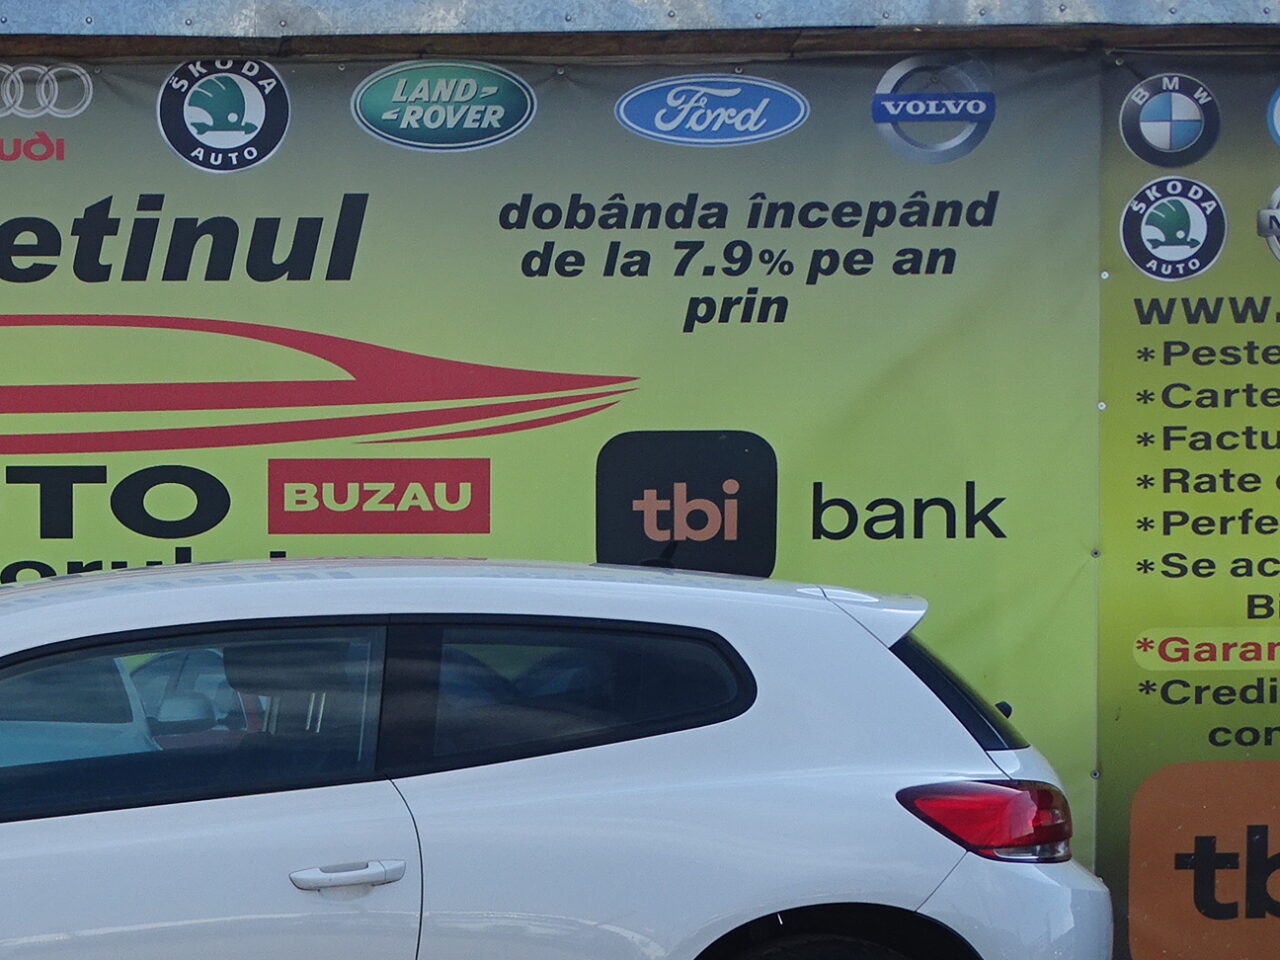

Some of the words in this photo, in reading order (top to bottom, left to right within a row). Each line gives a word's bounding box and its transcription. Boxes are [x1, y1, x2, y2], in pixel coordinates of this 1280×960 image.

[654, 85, 770, 131] Ford
[881, 99, 987, 115] VOLVO
[1131, 76, 1213, 106] BMW
[190, 146, 258, 166] AUTO
[499, 193, 727, 230] dobânda
[746, 191, 999, 237] începând
[520, 241, 585, 277] de
[603, 241, 652, 277] la
[672, 240, 794, 277] 7.9%
[805, 246, 874, 285] pe
[891, 246, 957, 275] an
[1146, 256, 1201, 276] AUTO
[683, 287, 789, 333] prin
[283, 482, 473, 513] BUZAU
[632, 478, 740, 541] tbi
[812, 481, 1008, 540] bank
